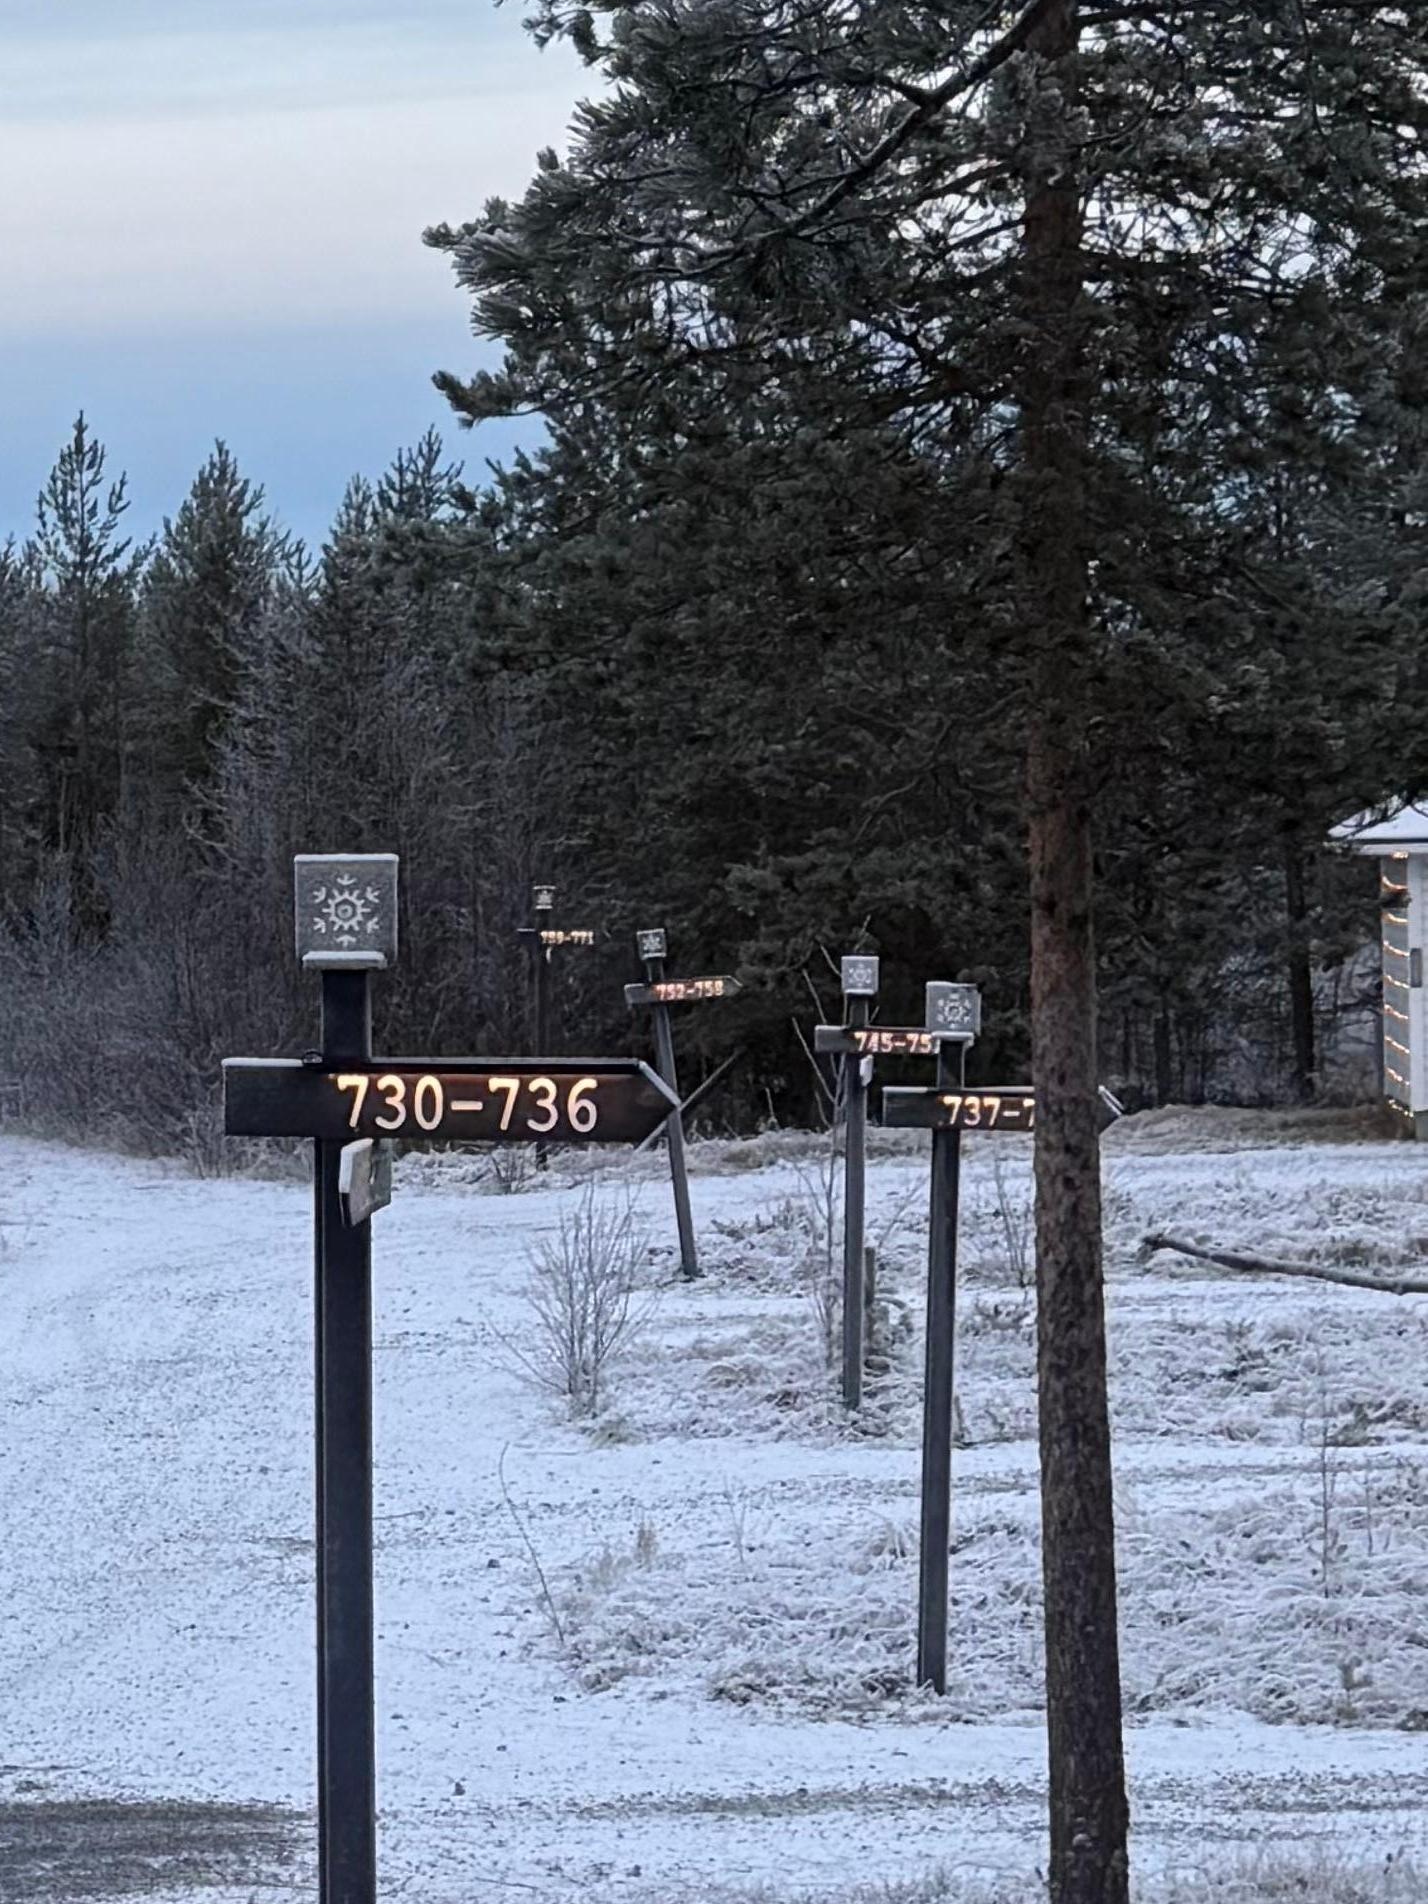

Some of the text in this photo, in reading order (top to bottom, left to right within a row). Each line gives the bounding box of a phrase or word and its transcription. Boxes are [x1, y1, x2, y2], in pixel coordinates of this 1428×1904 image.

[853, 1031, 939, 1055] 745-75
[337, 1074, 599, 1133] 730-736
[943, 1095, 1035, 1128] 737-7
